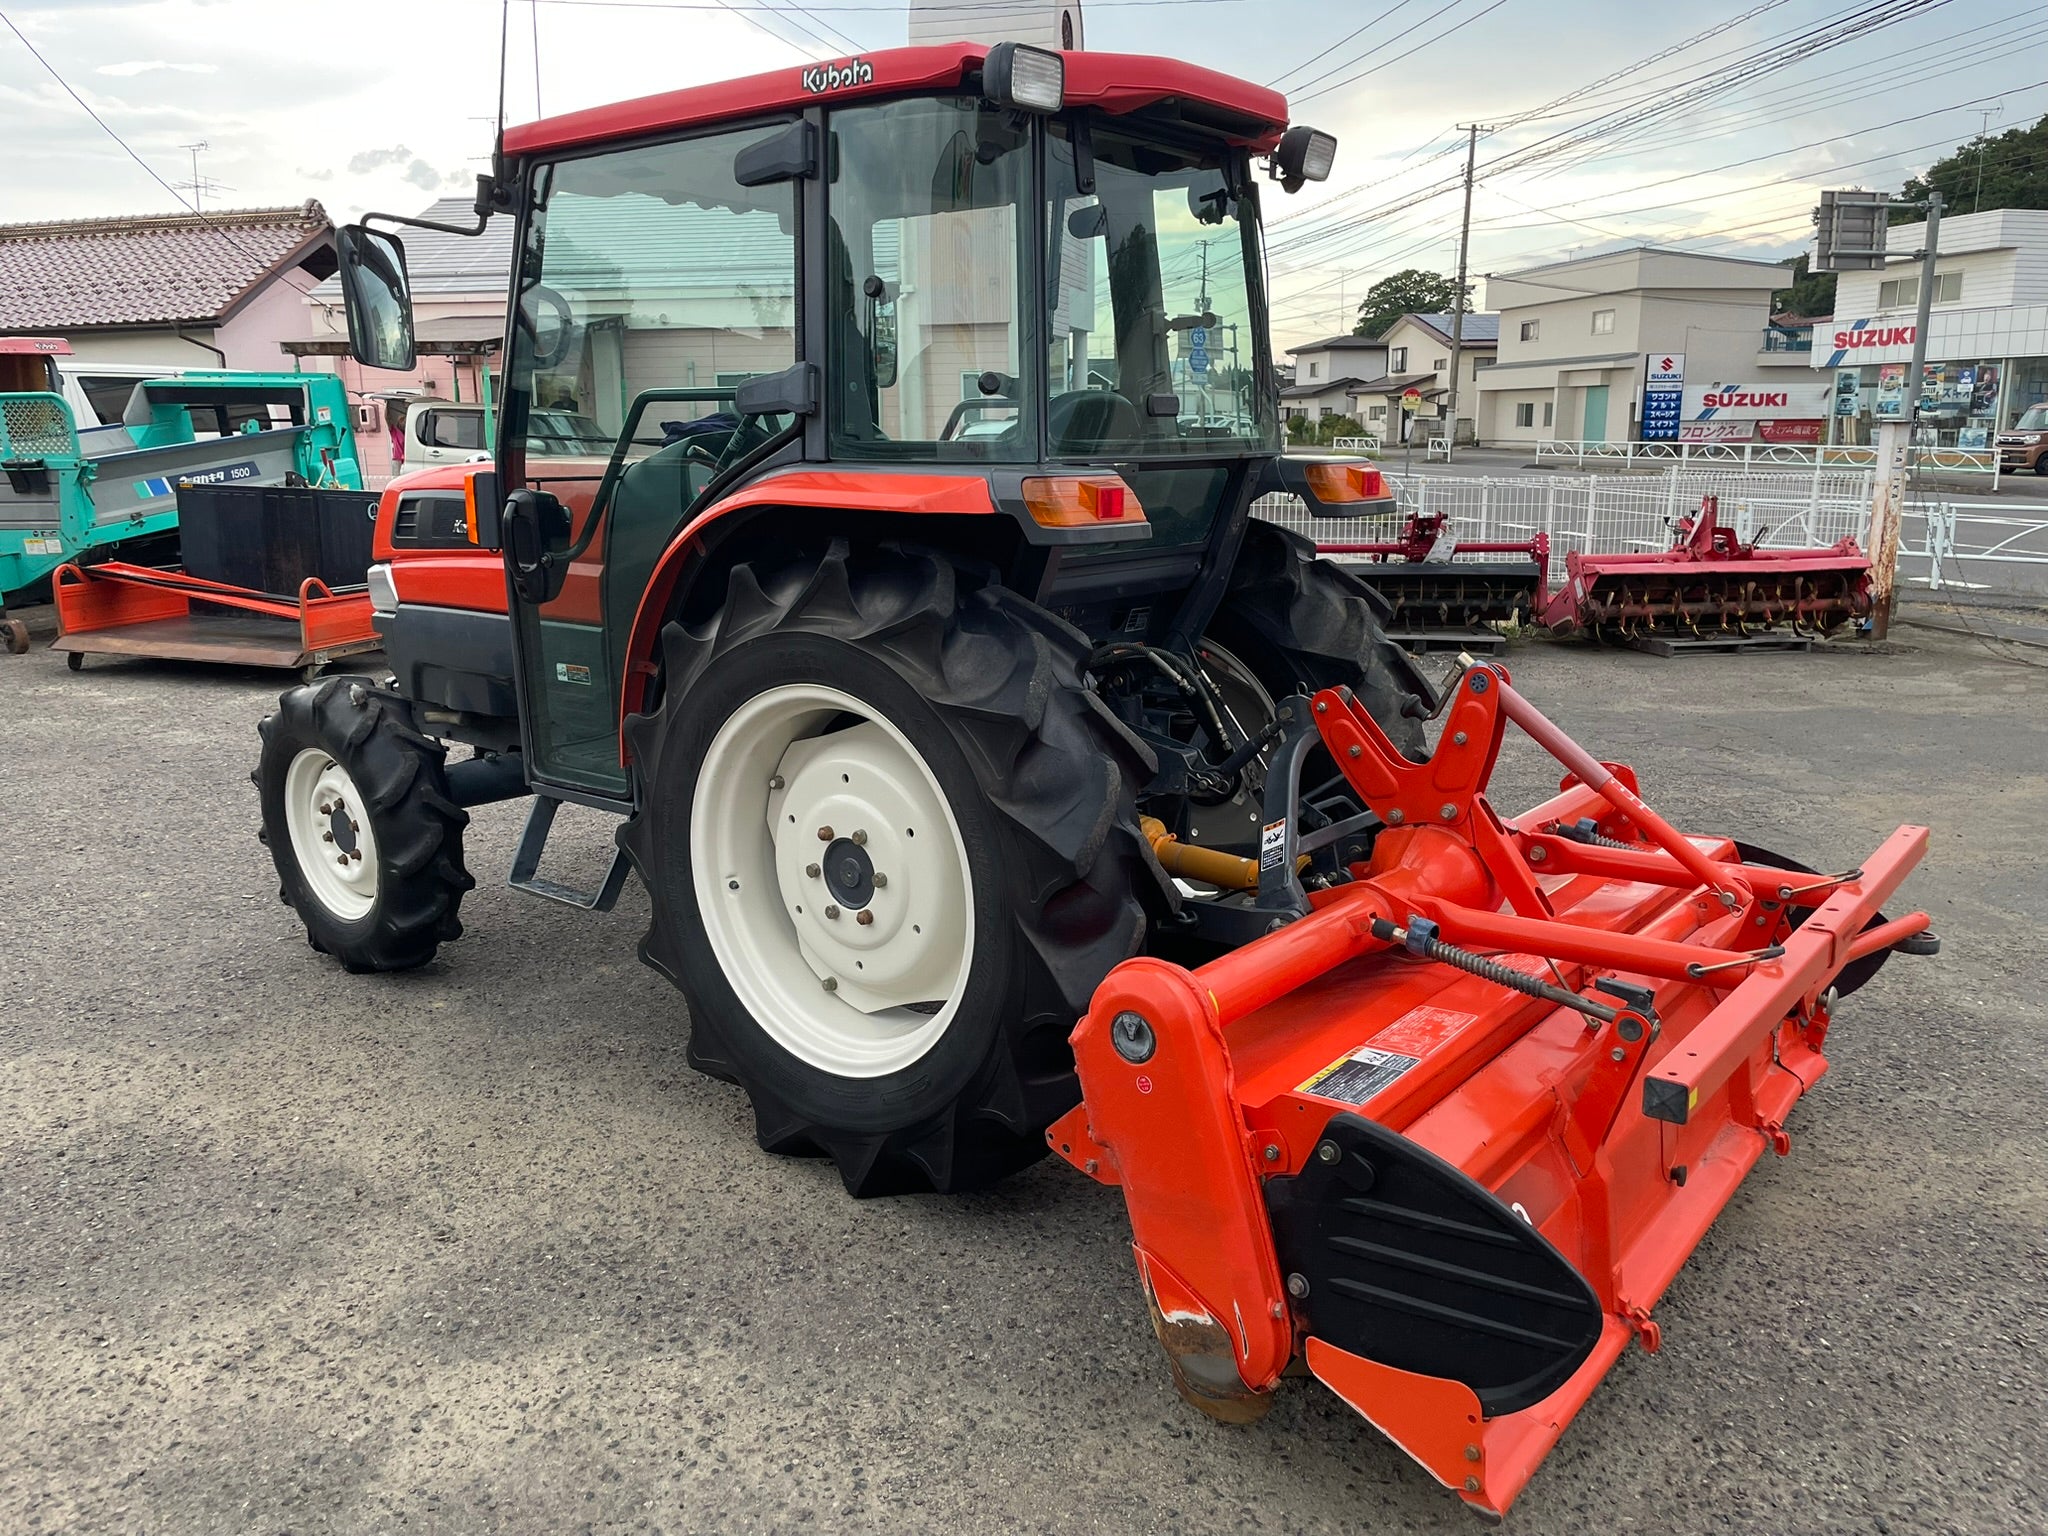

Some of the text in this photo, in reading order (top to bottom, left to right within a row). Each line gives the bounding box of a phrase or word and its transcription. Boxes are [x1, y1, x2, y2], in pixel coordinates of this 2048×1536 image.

[802, 58, 873, 93] Kubota
[1193, 333, 1204, 344] 63
[1834, 327, 1917, 349] SUZUKI
[1703, 393, 1788, 408] SUZUKI
[1682, 425, 1737, 438] フロンクス
[230, 467, 250, 479] 1500
